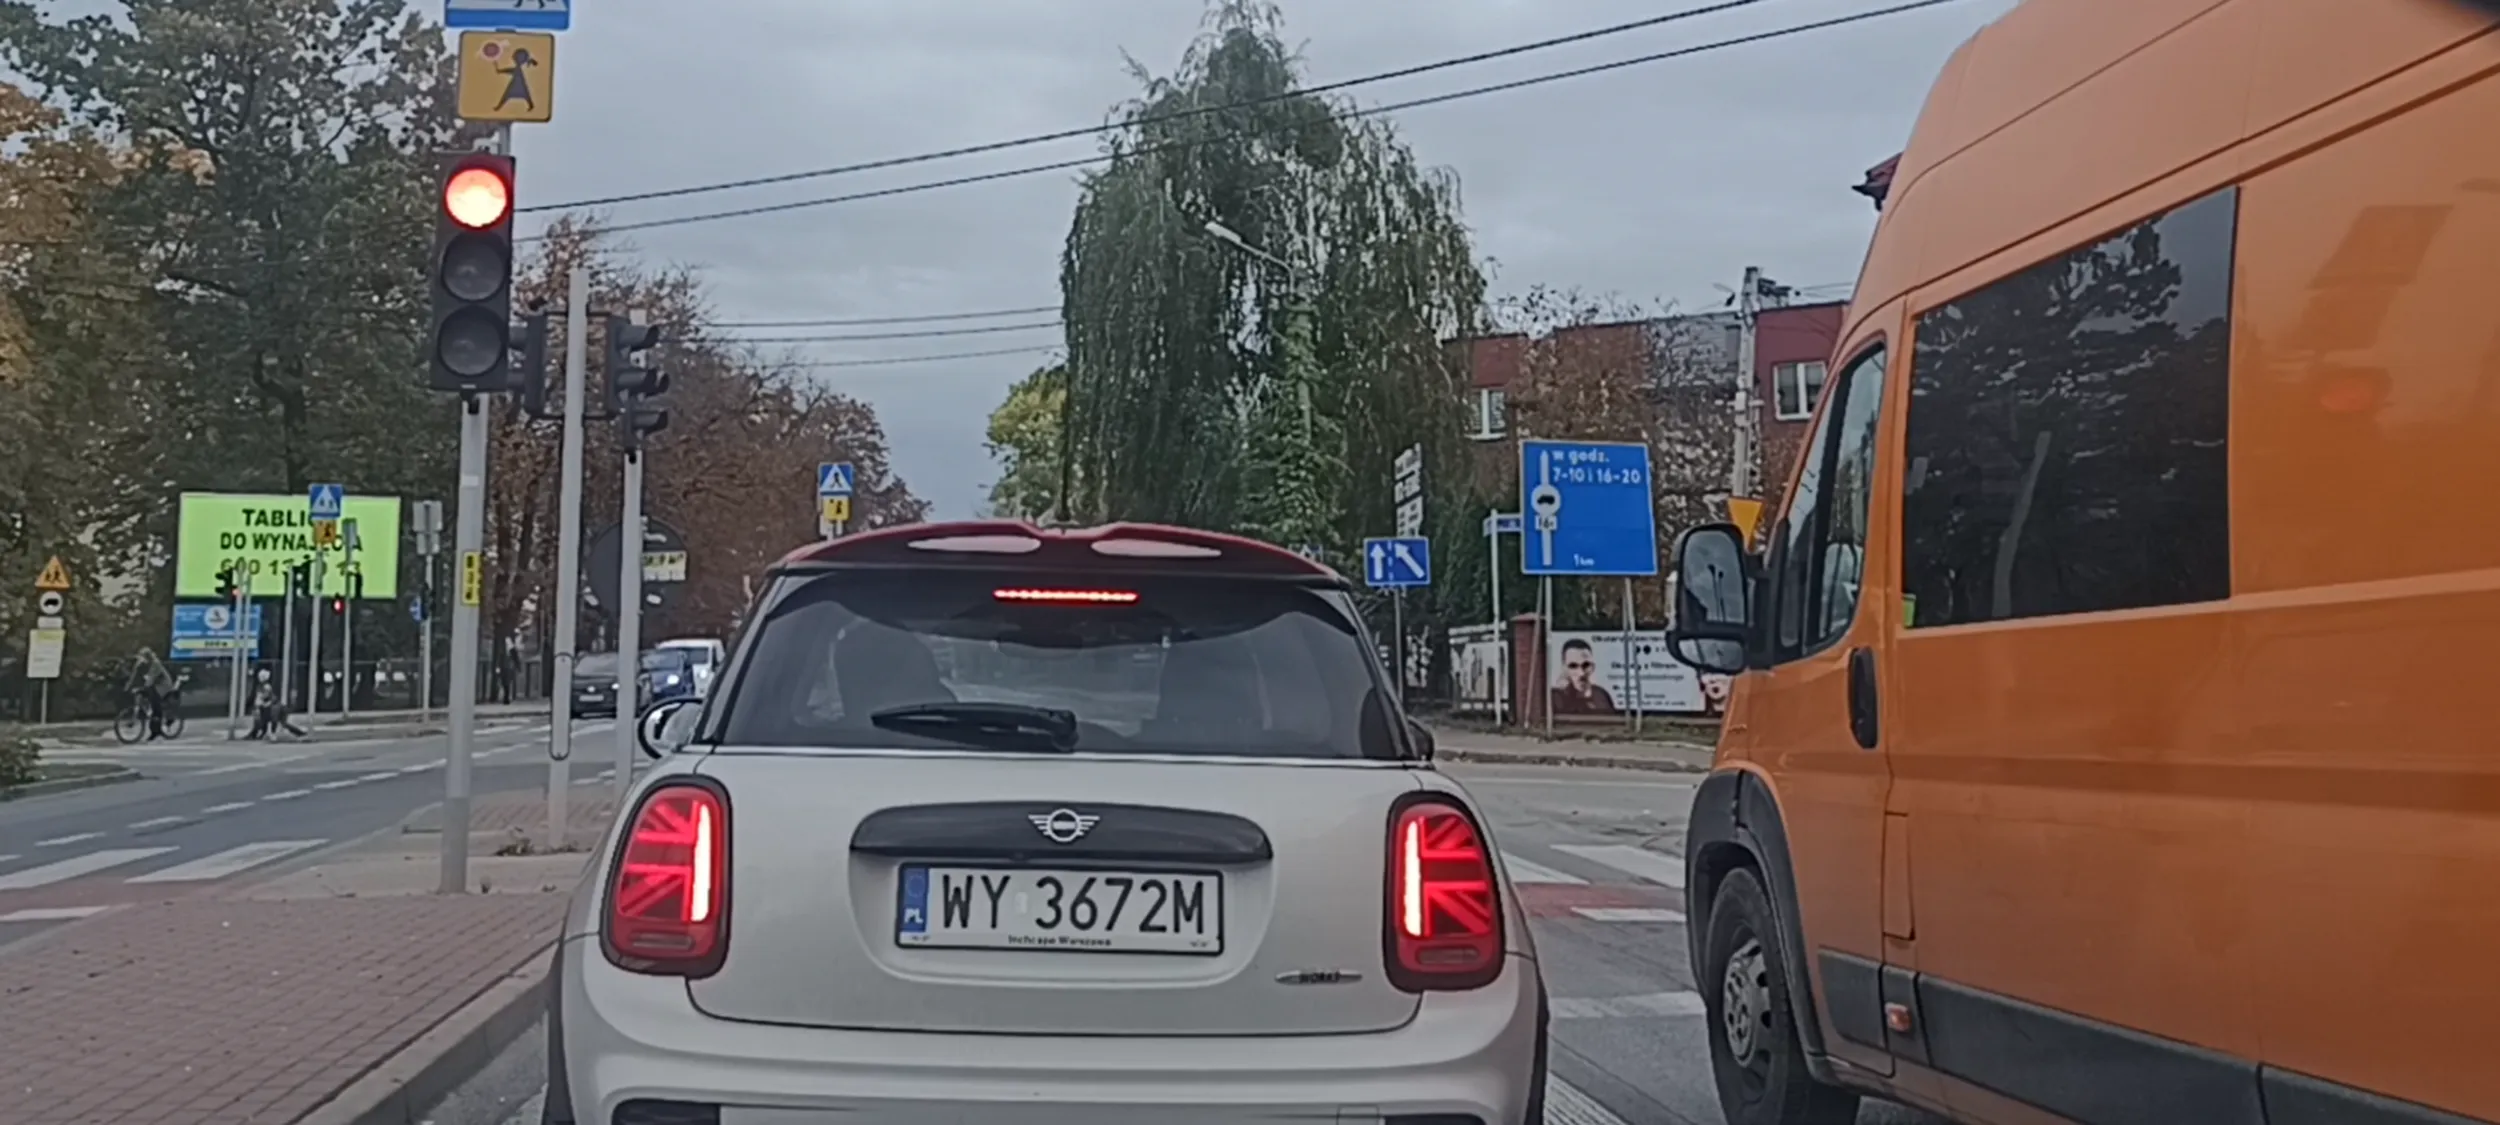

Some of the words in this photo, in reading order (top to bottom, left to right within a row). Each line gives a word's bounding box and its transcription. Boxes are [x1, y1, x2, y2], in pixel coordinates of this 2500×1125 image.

[1552, 450, 1564, 461] w
[1568, 448, 1610, 465] godz.
[1553, 467, 1585, 482] 7-10
[1588, 468, 1593, 482] i
[1597, 469, 1641, 484] 16-20
[220, 532, 247, 550] DO
[1573, 554, 1579, 567] 1
[1580, 558, 1594, 566] km
[943, 874, 1011, 929] WY
[1035, 875, 1204, 935] 3672M
[904, 908, 923, 924] PL
